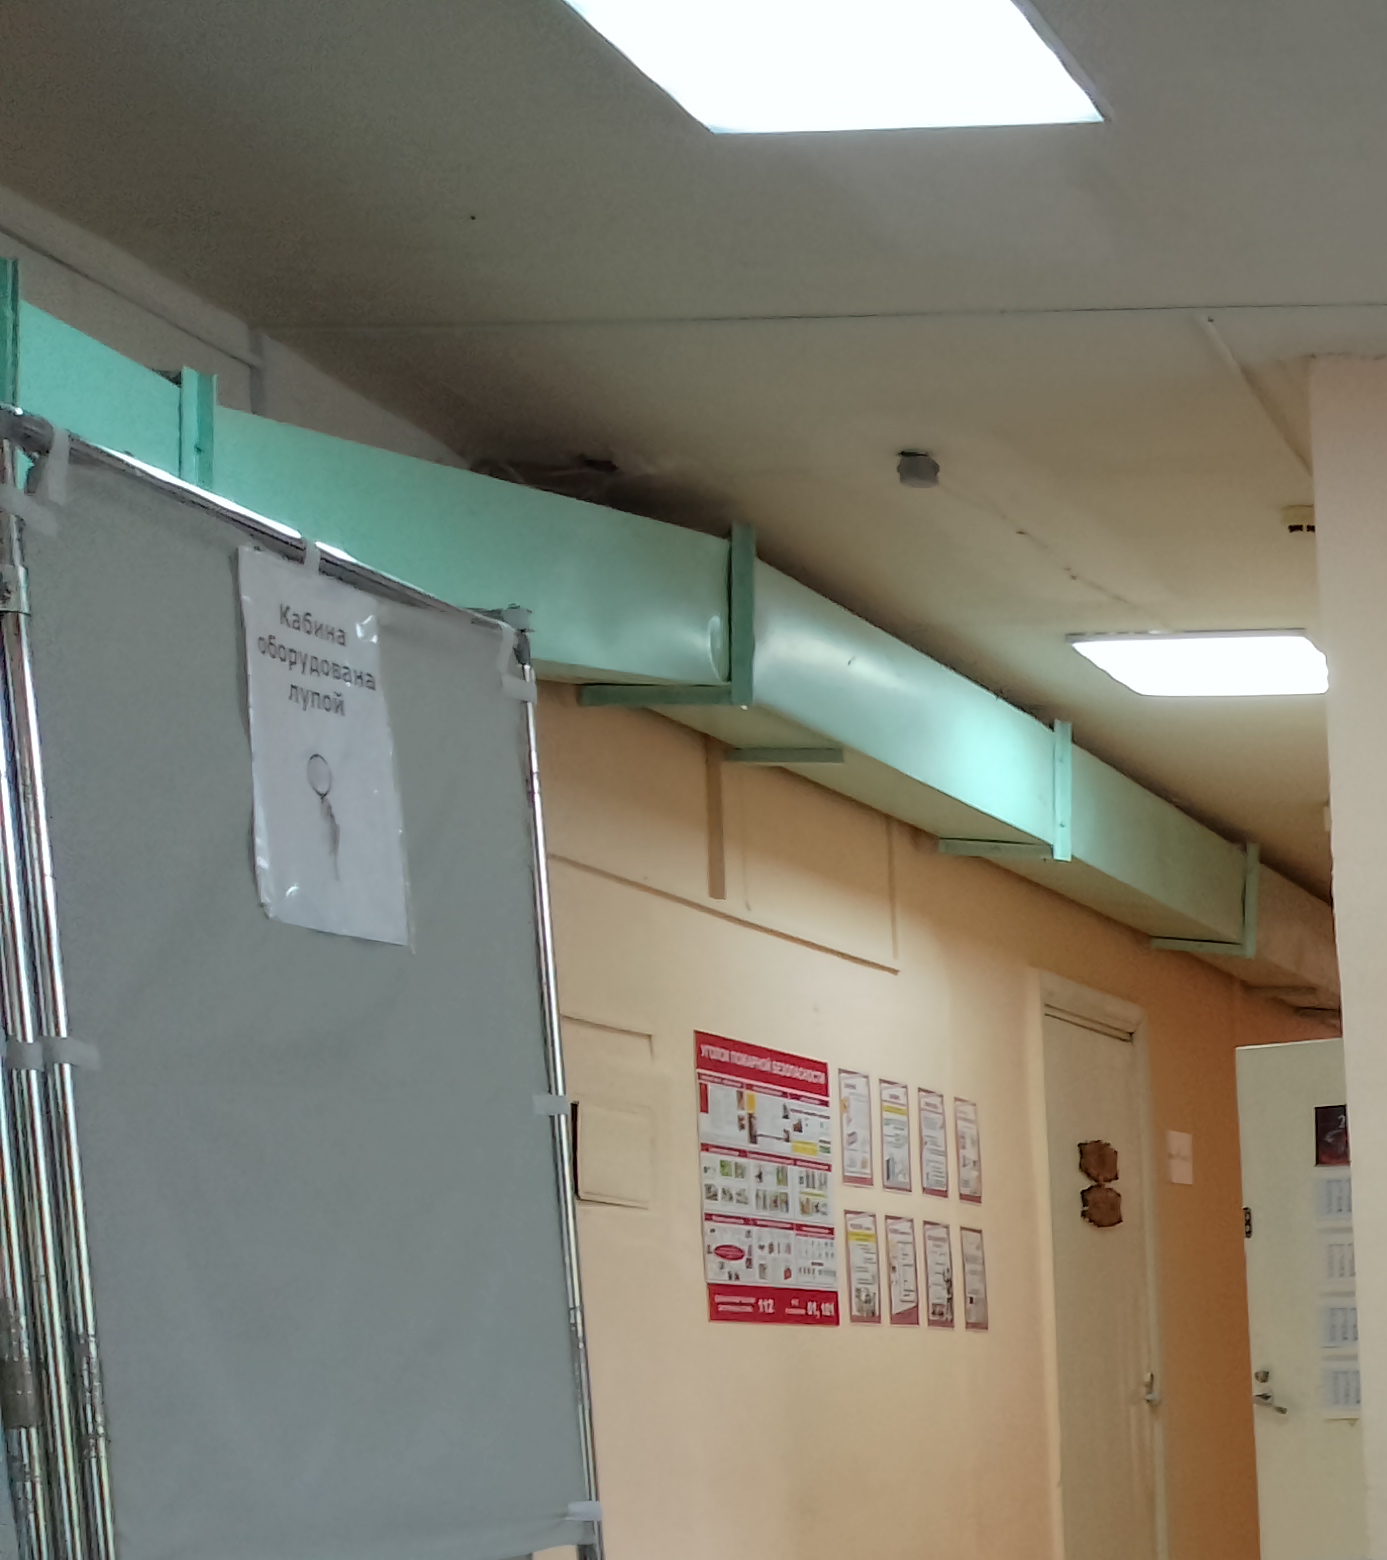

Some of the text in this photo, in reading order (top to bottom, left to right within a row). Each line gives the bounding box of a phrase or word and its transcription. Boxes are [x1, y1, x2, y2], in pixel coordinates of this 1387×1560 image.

[278, 603, 348, 647] Кабина
[257, 635, 377, 692] оборудована
[288, 681, 346, 718] лупой
